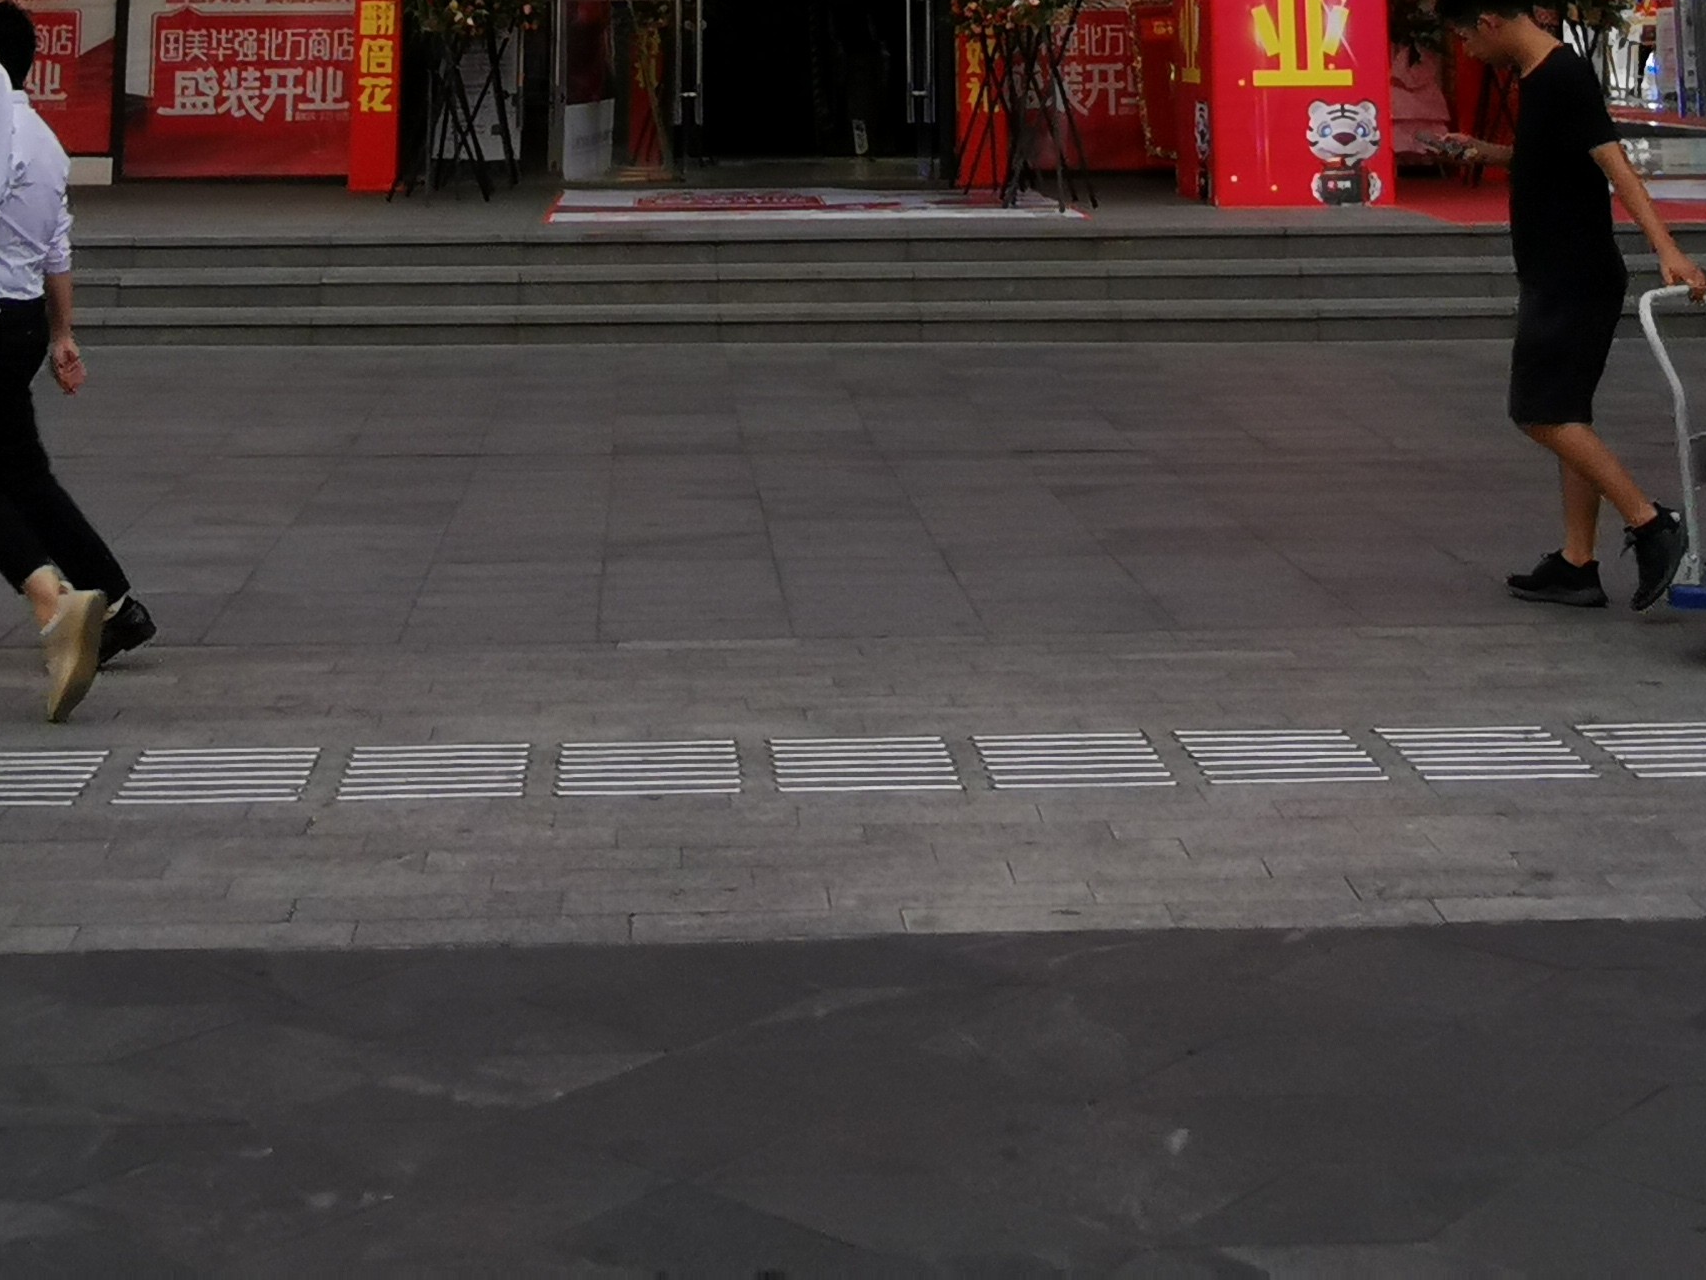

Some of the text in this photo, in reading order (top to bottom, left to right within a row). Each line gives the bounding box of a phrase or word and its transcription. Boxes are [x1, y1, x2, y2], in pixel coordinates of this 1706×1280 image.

[159, 28, 356, 63] 国美华强北万商店
[156, 66, 351, 122] 盛装开业
